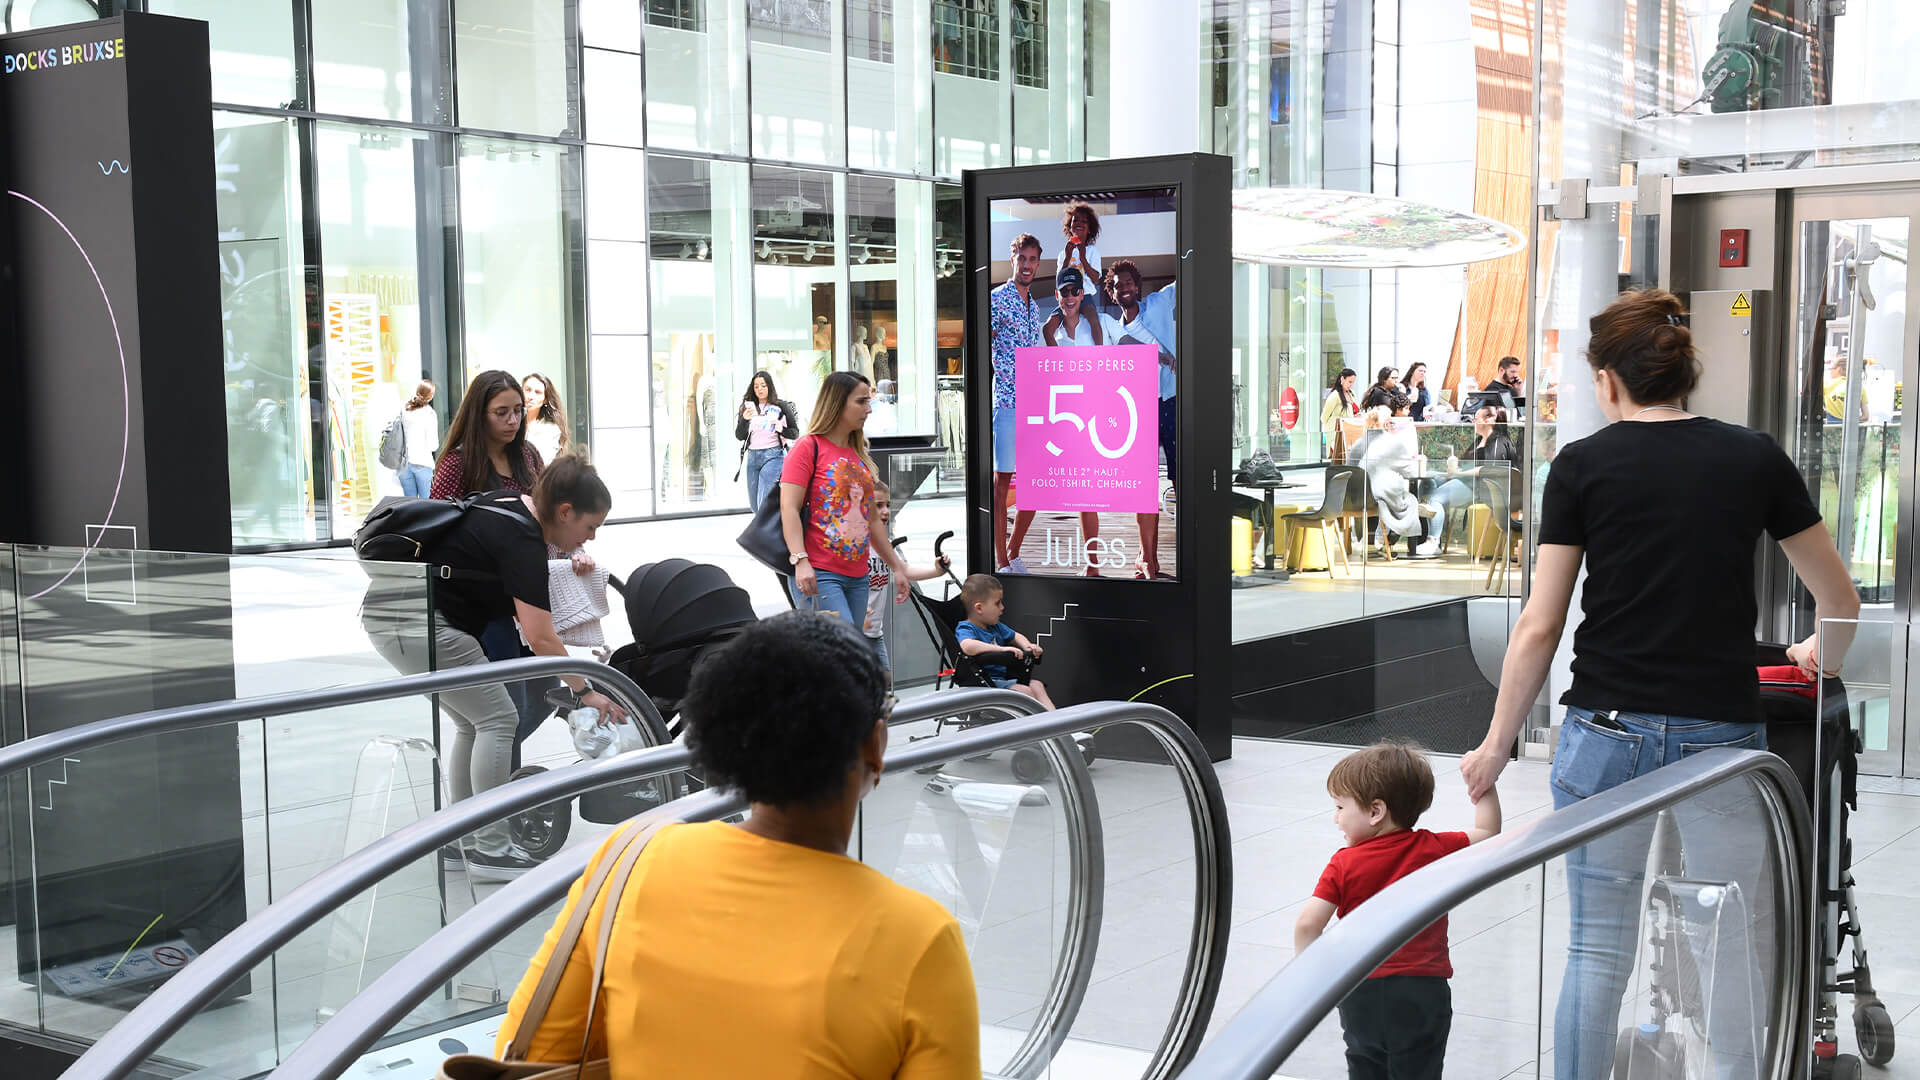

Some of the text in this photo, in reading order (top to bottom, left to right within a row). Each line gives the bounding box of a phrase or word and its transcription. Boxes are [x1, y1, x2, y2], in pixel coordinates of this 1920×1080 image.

[5, 38, 124, 73] DOCKS BRUXSE
[1070, 360, 1093, 372] DES
[1048, 467, 1066, 476] SUR
[1069, 467, 1078, 476] LE
[1094, 467, 1119, 477] HAUT
[1041, 527, 1126, 569] Jules
